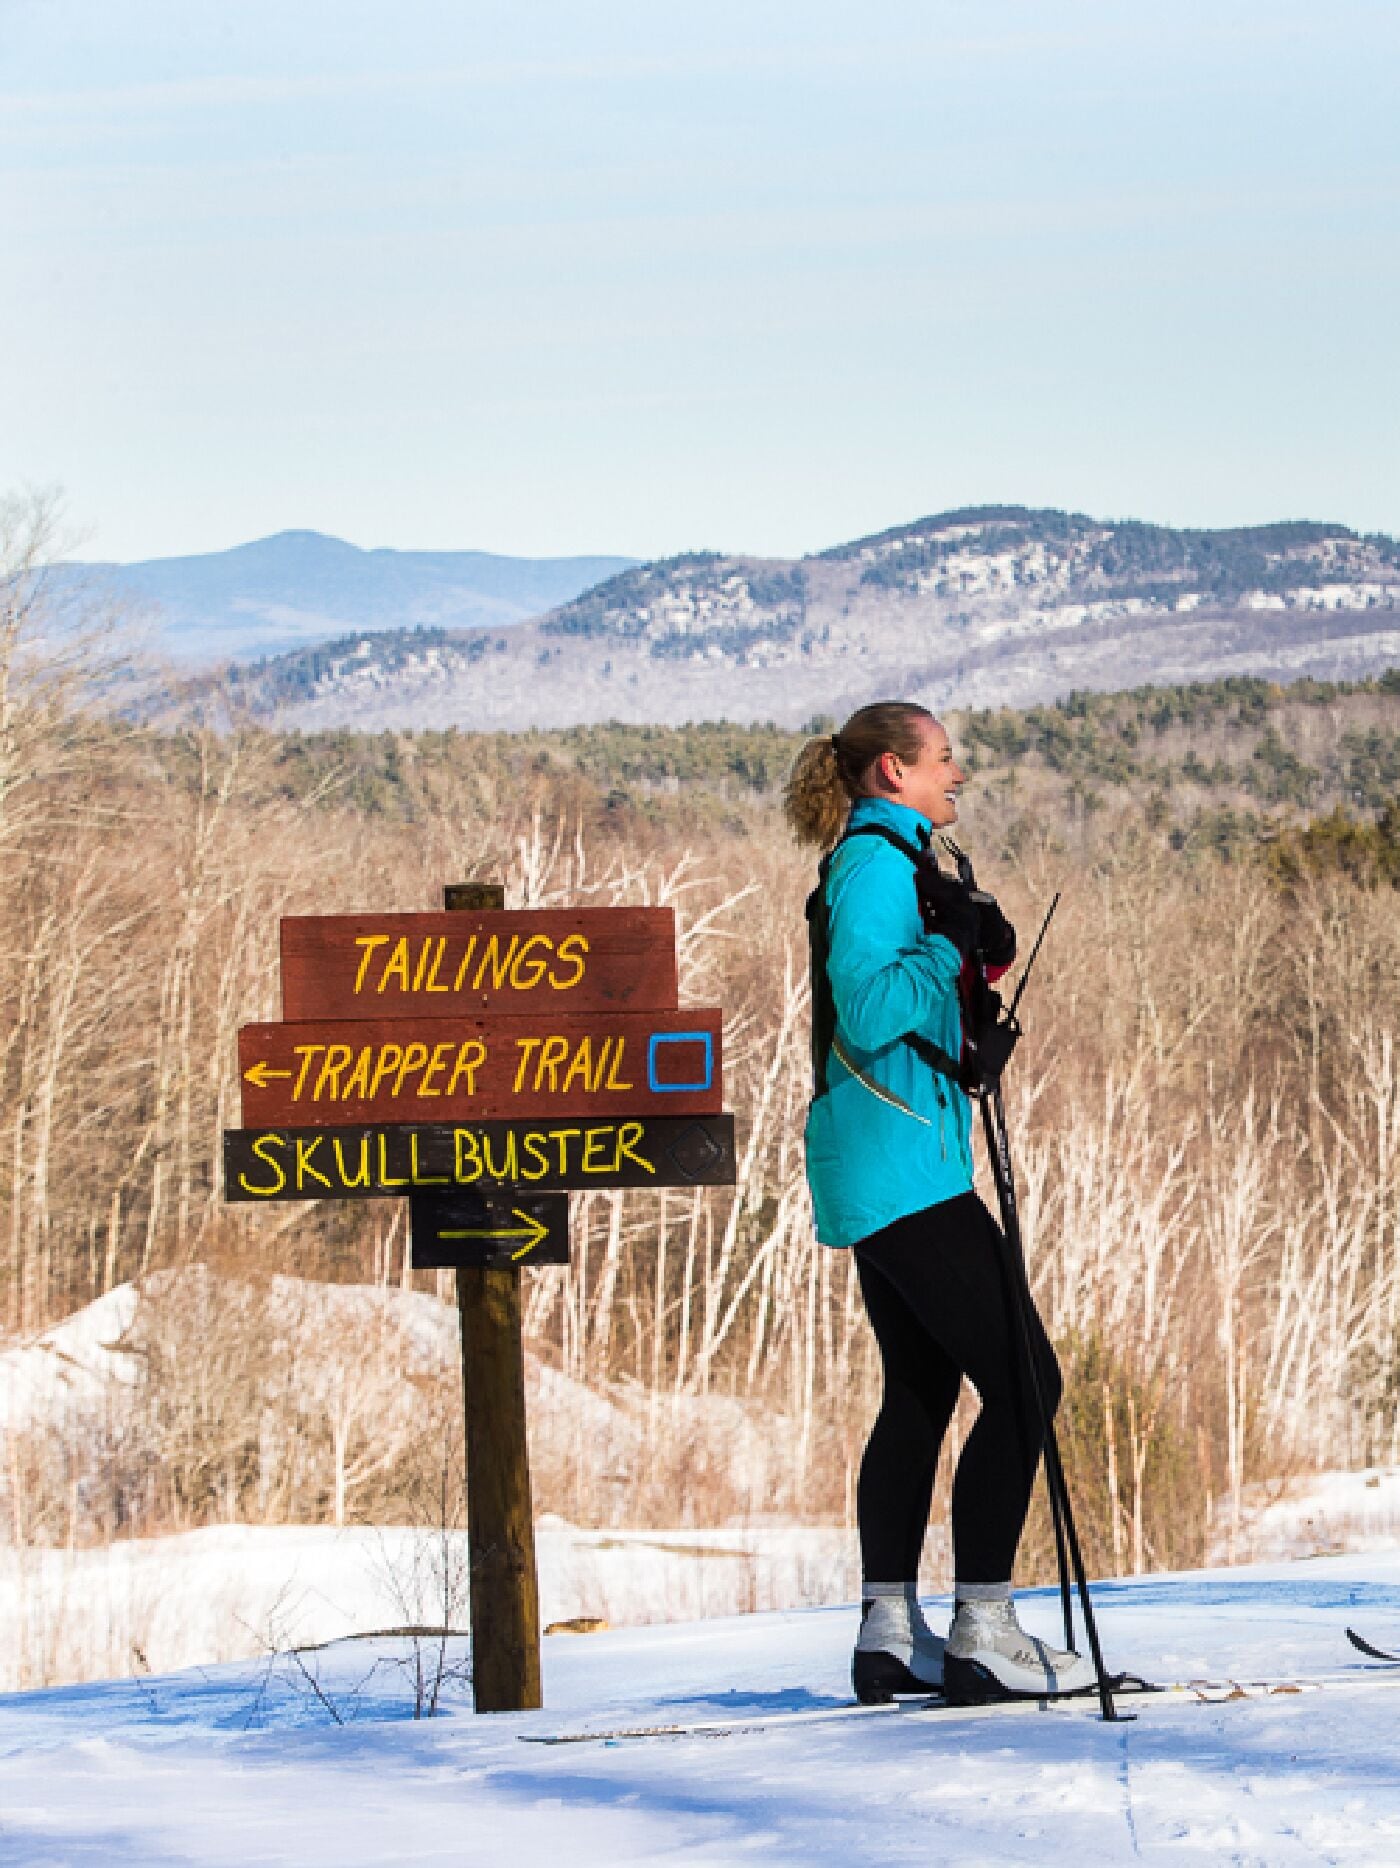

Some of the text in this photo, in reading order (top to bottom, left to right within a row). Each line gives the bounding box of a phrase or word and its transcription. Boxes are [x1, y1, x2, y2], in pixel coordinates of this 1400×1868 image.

[354, 933, 590, 994] TAILINGS
[291, 1035, 634, 1102] TRAPPER TRAIL
